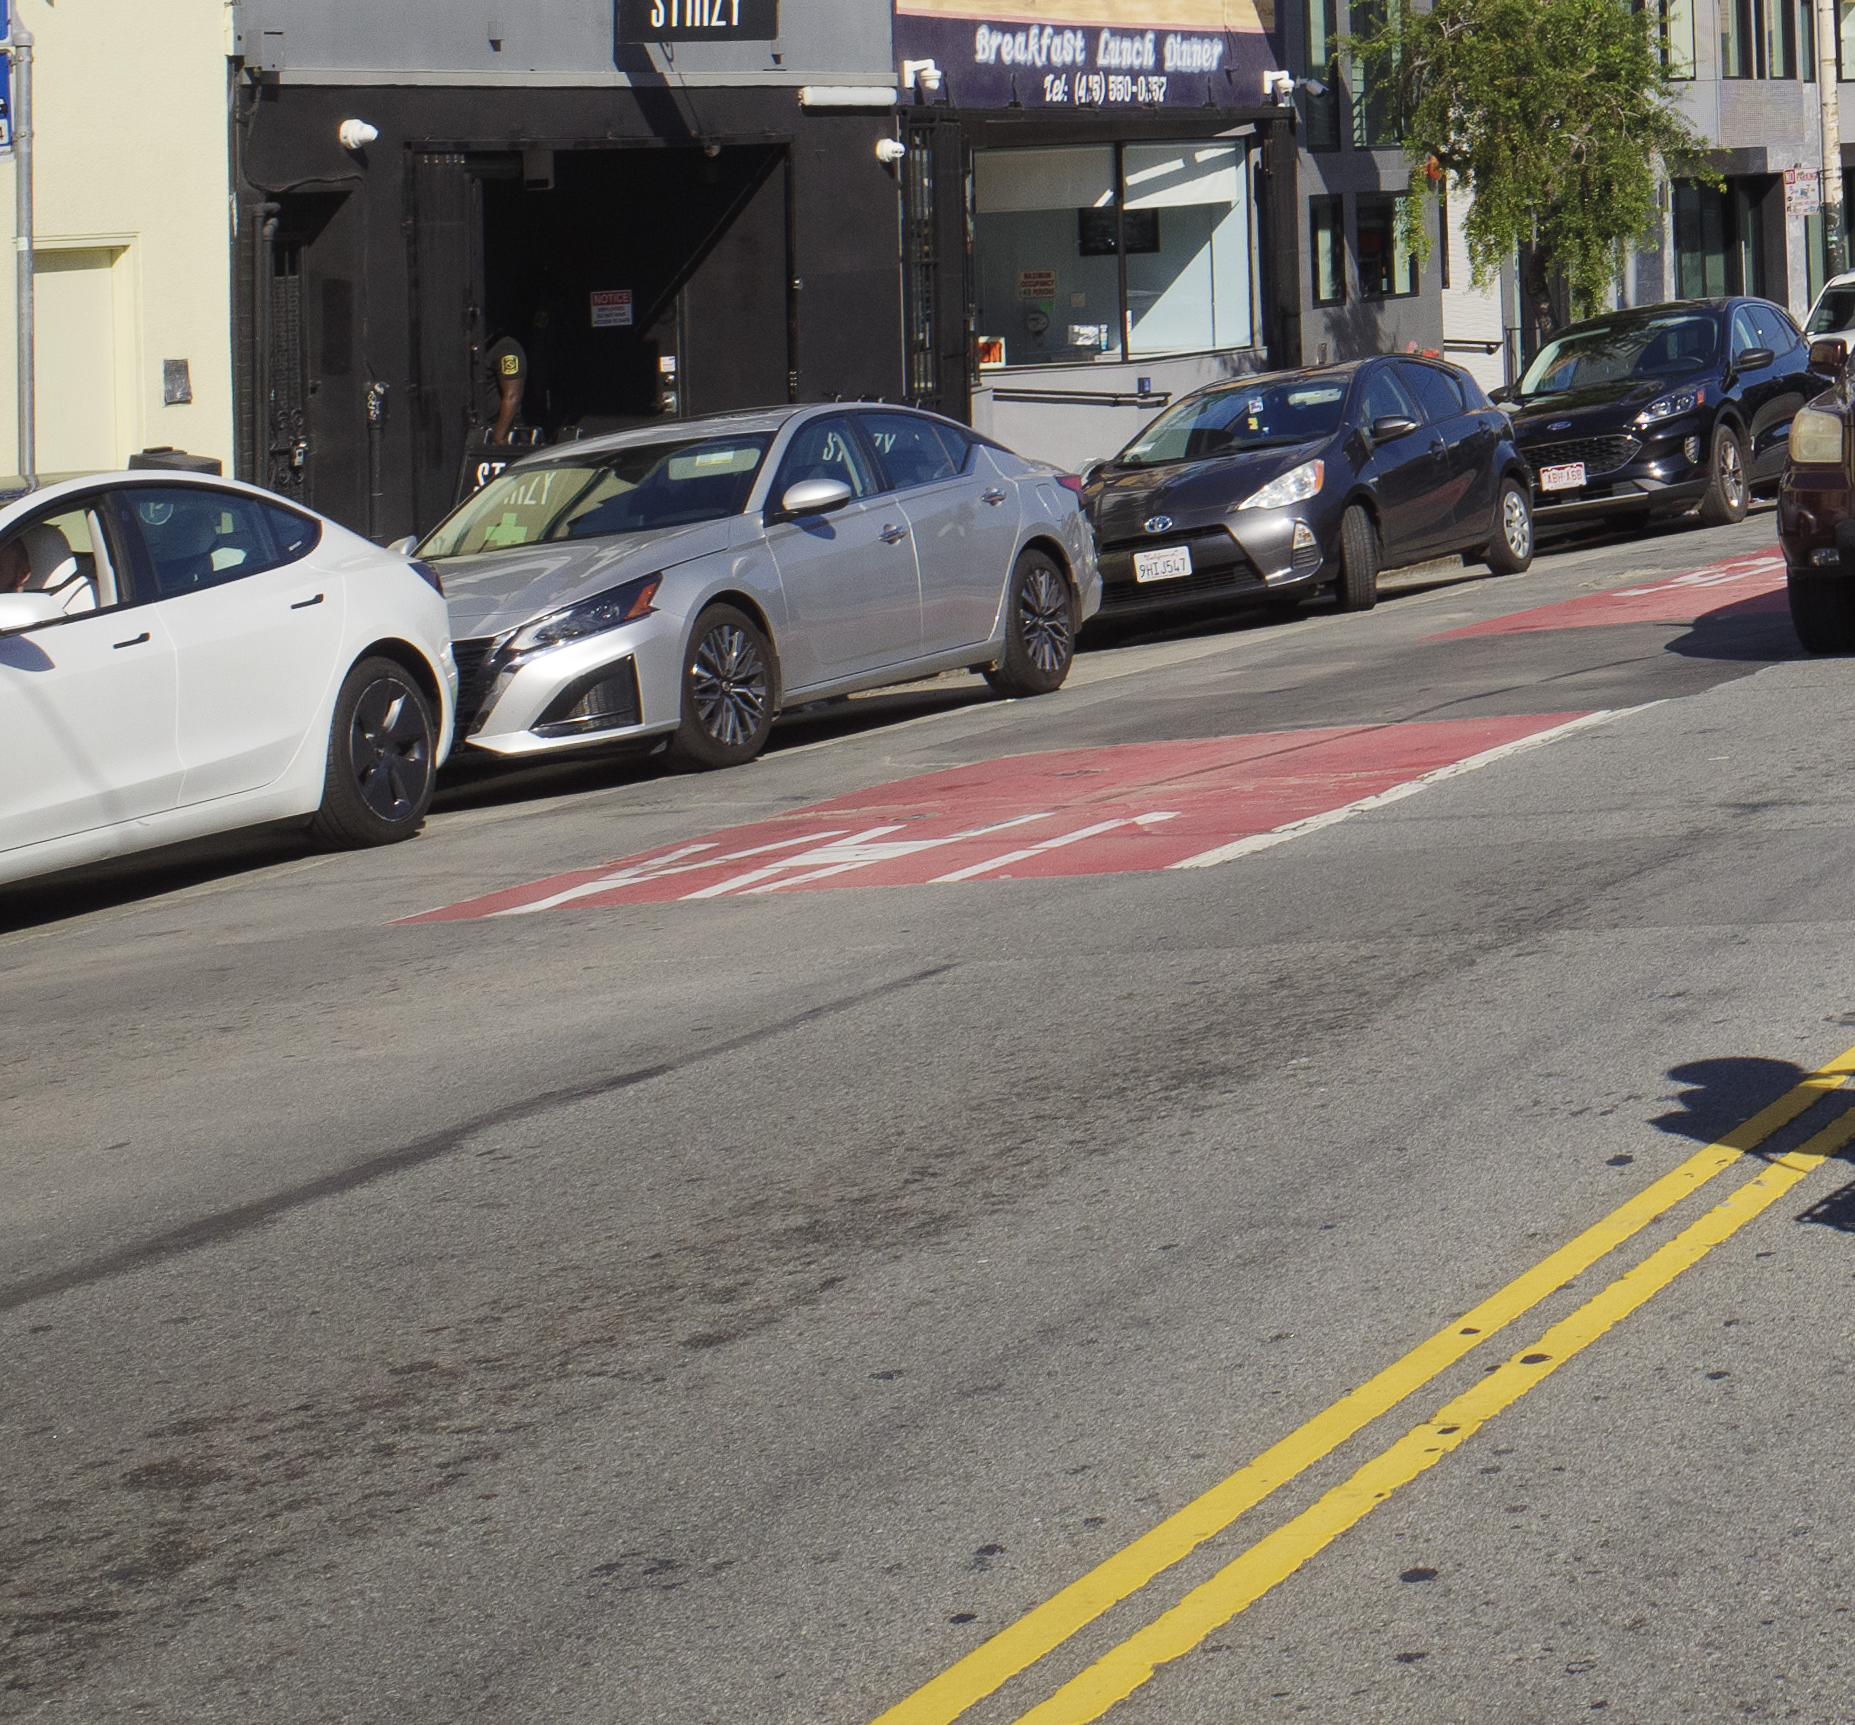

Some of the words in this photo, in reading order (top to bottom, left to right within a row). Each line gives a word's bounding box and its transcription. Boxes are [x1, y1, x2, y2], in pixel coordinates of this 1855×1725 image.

[1097, 27, 1155, 69] Lunch
[1164, 32, 1223, 73] Dinner
[1043, 73, 1069, 103] Tel:
[593, 293, 630, 305] NOTICE
